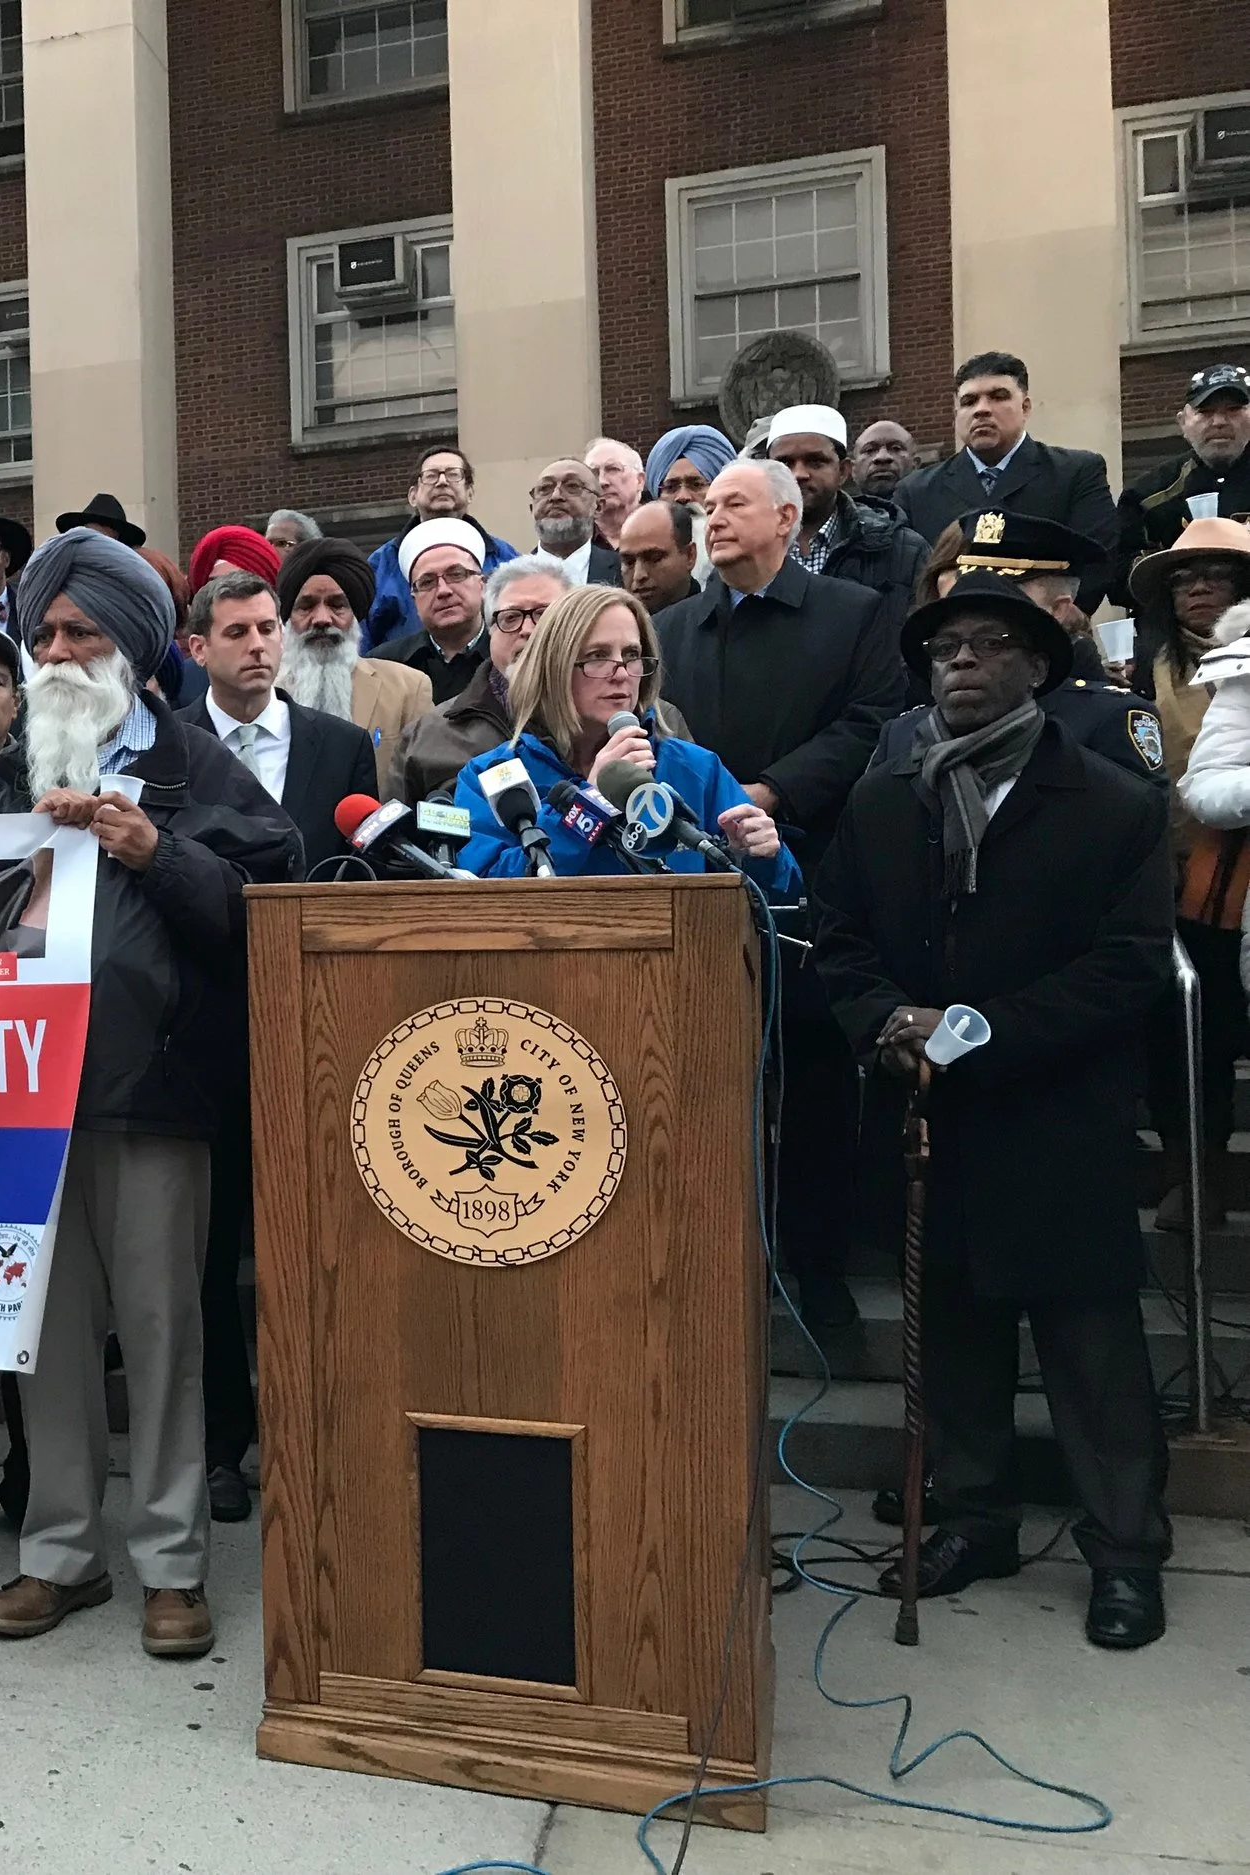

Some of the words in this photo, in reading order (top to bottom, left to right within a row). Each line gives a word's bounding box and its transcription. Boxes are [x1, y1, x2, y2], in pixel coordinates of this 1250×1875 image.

[565, 804, 581, 824] FOX
[576, 812, 594, 833] 5
[626, 823, 644, 849] abc
[395, 1040, 441, 1090] QUEENS
[519, 1038, 562, 1071] CITY
[558, 1073, 579, 1096] OF
[389, 1092, 403, 1113] OF
[570, 1102, 586, 1144] NEW
[388, 1118, 428, 1190] BOROUGH
[546, 1150, 583, 1195] YORK
[462, 1200, 511, 1223] 1898
